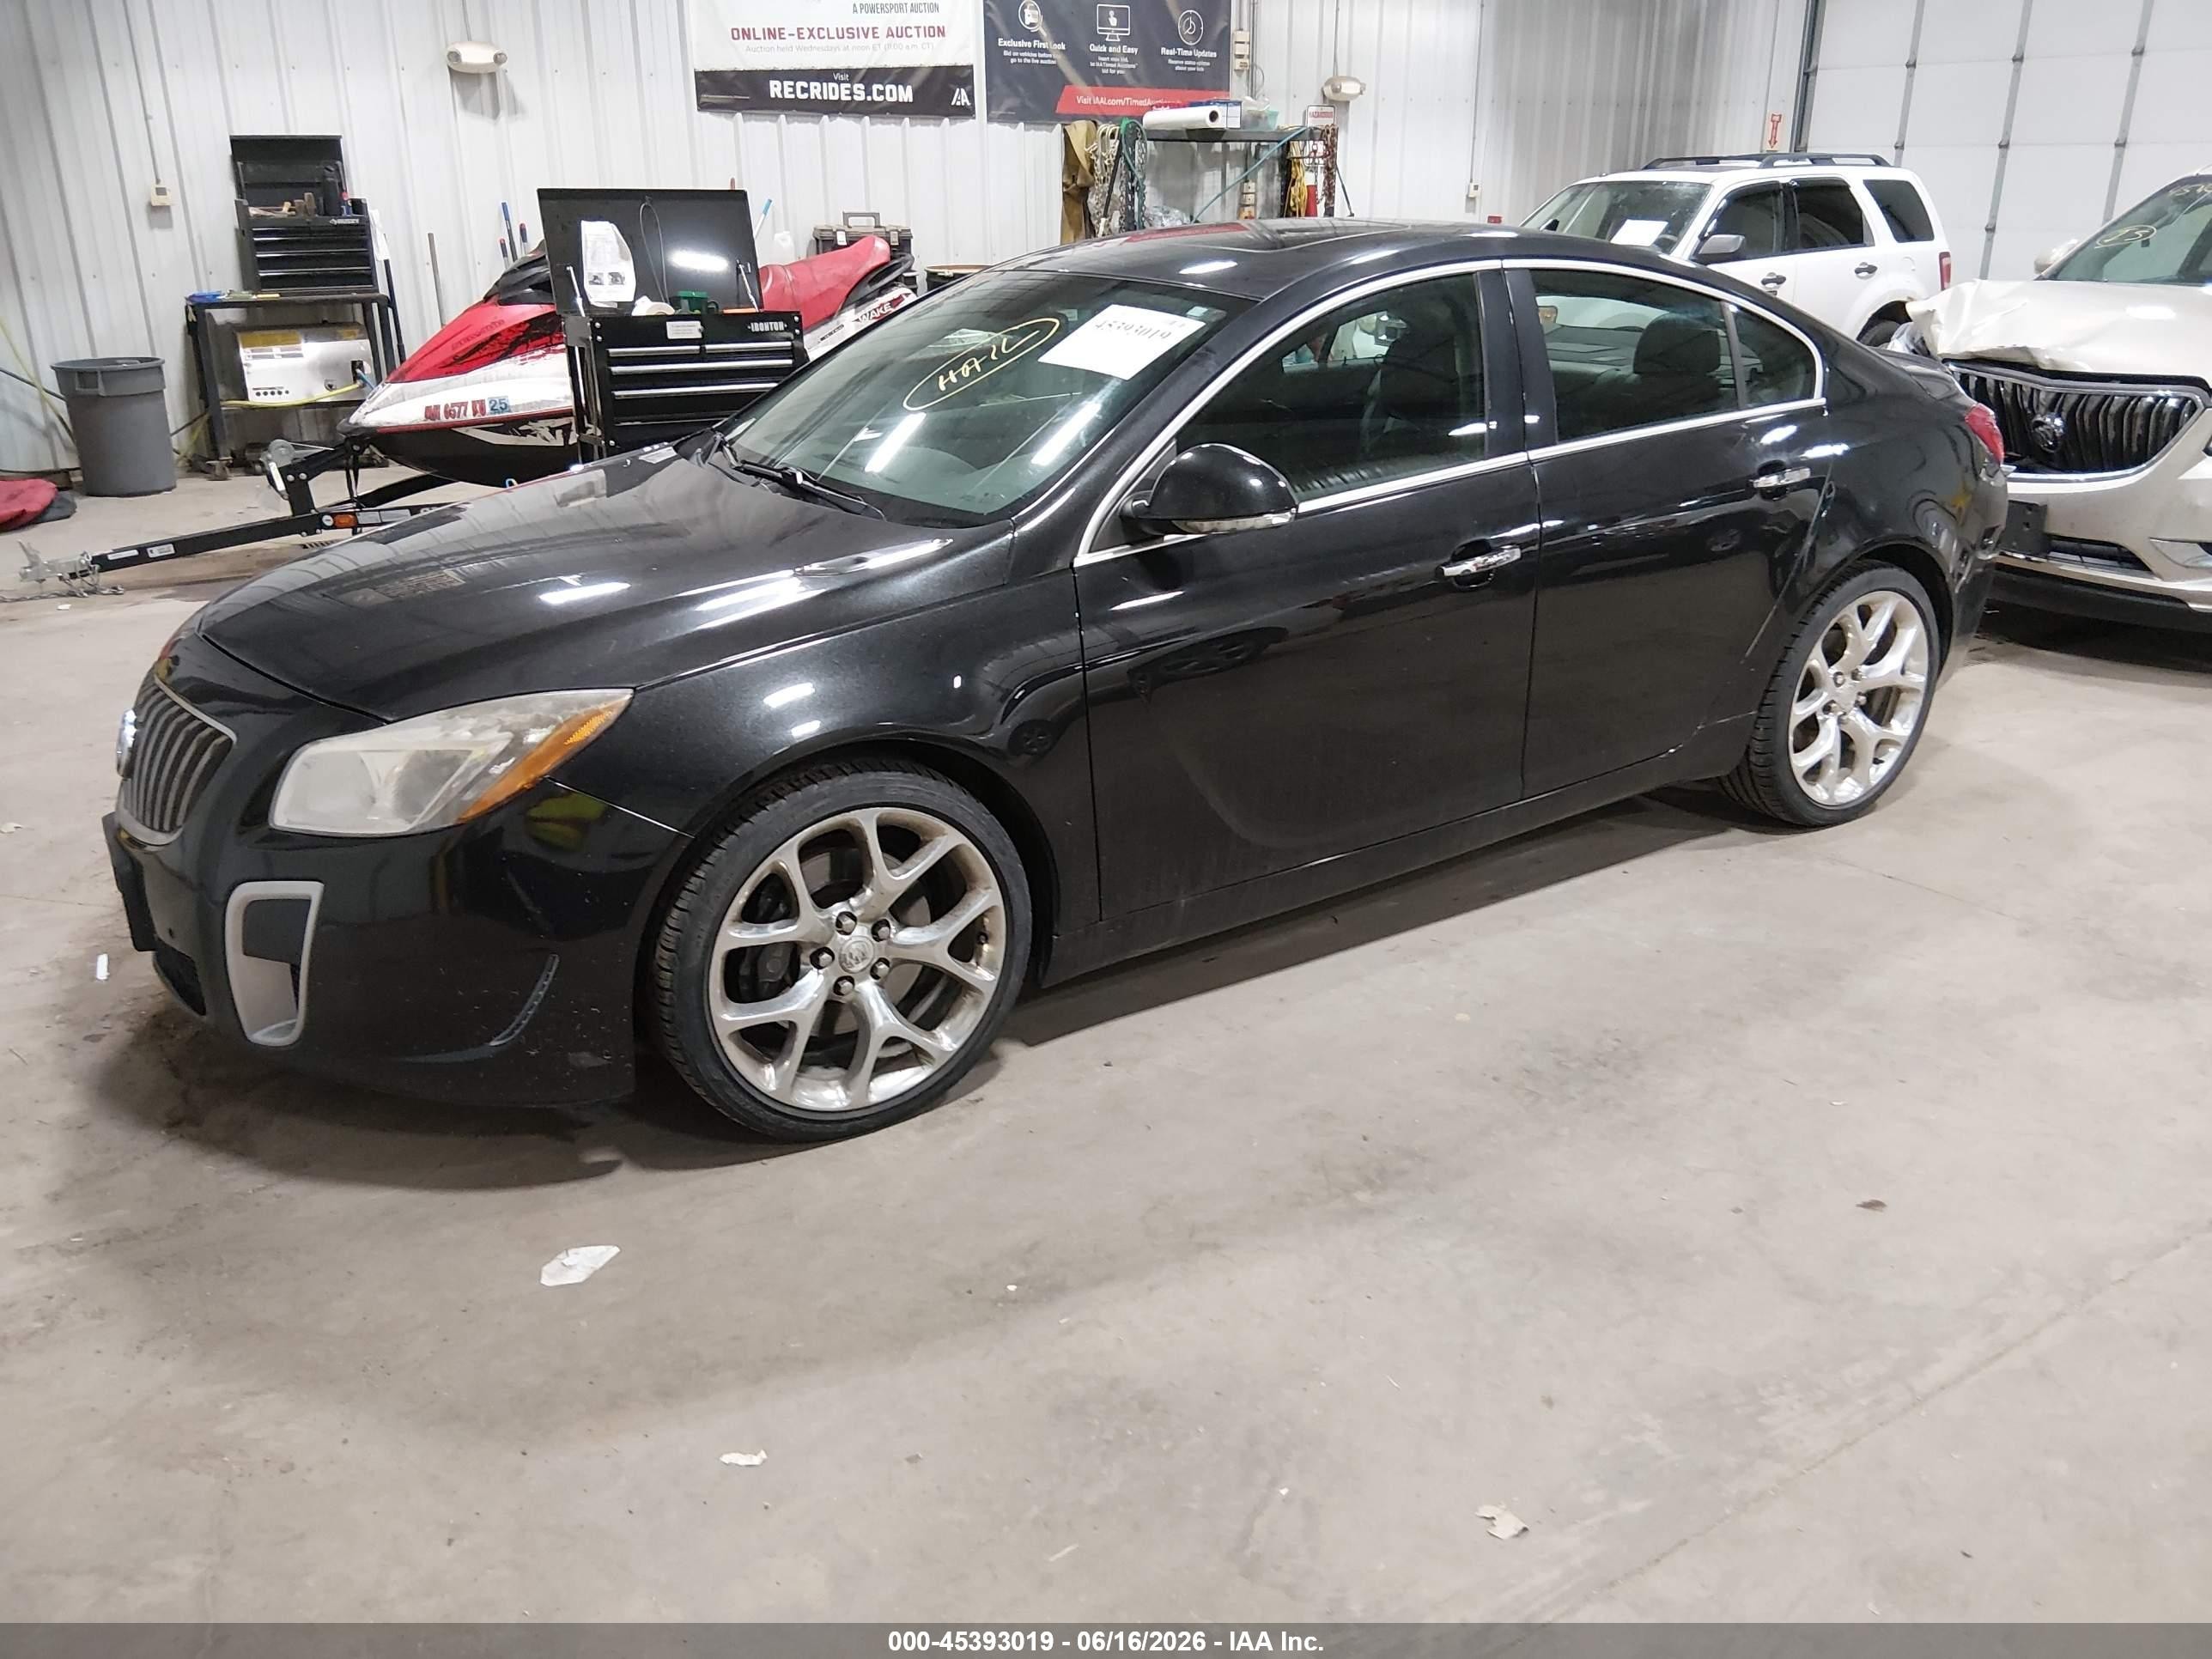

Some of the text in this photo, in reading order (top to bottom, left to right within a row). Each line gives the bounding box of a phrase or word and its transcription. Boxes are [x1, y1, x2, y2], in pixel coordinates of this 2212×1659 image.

[860, 3, 908, 14] POWERSPORT
[910, 3, 939, 14] AUCTION
[731, 26, 946, 41] ONLINE-EXCLUSIVE AUCTION
[998, 38, 1031, 47] Exclusive
[1033, 40, 1048, 49] First
[1090, 44, 1138, 55] Quick and Easy
[1161, 46, 1217, 58] Real-Time Updates
[833, 72, 848, 82] Visit
[769, 80, 913, 102] RECRIDES.COM
[1077, 96, 1091, 105] Visit
[859, 301, 893, 324] WAKE
[488, 398, 508, 412] 25
